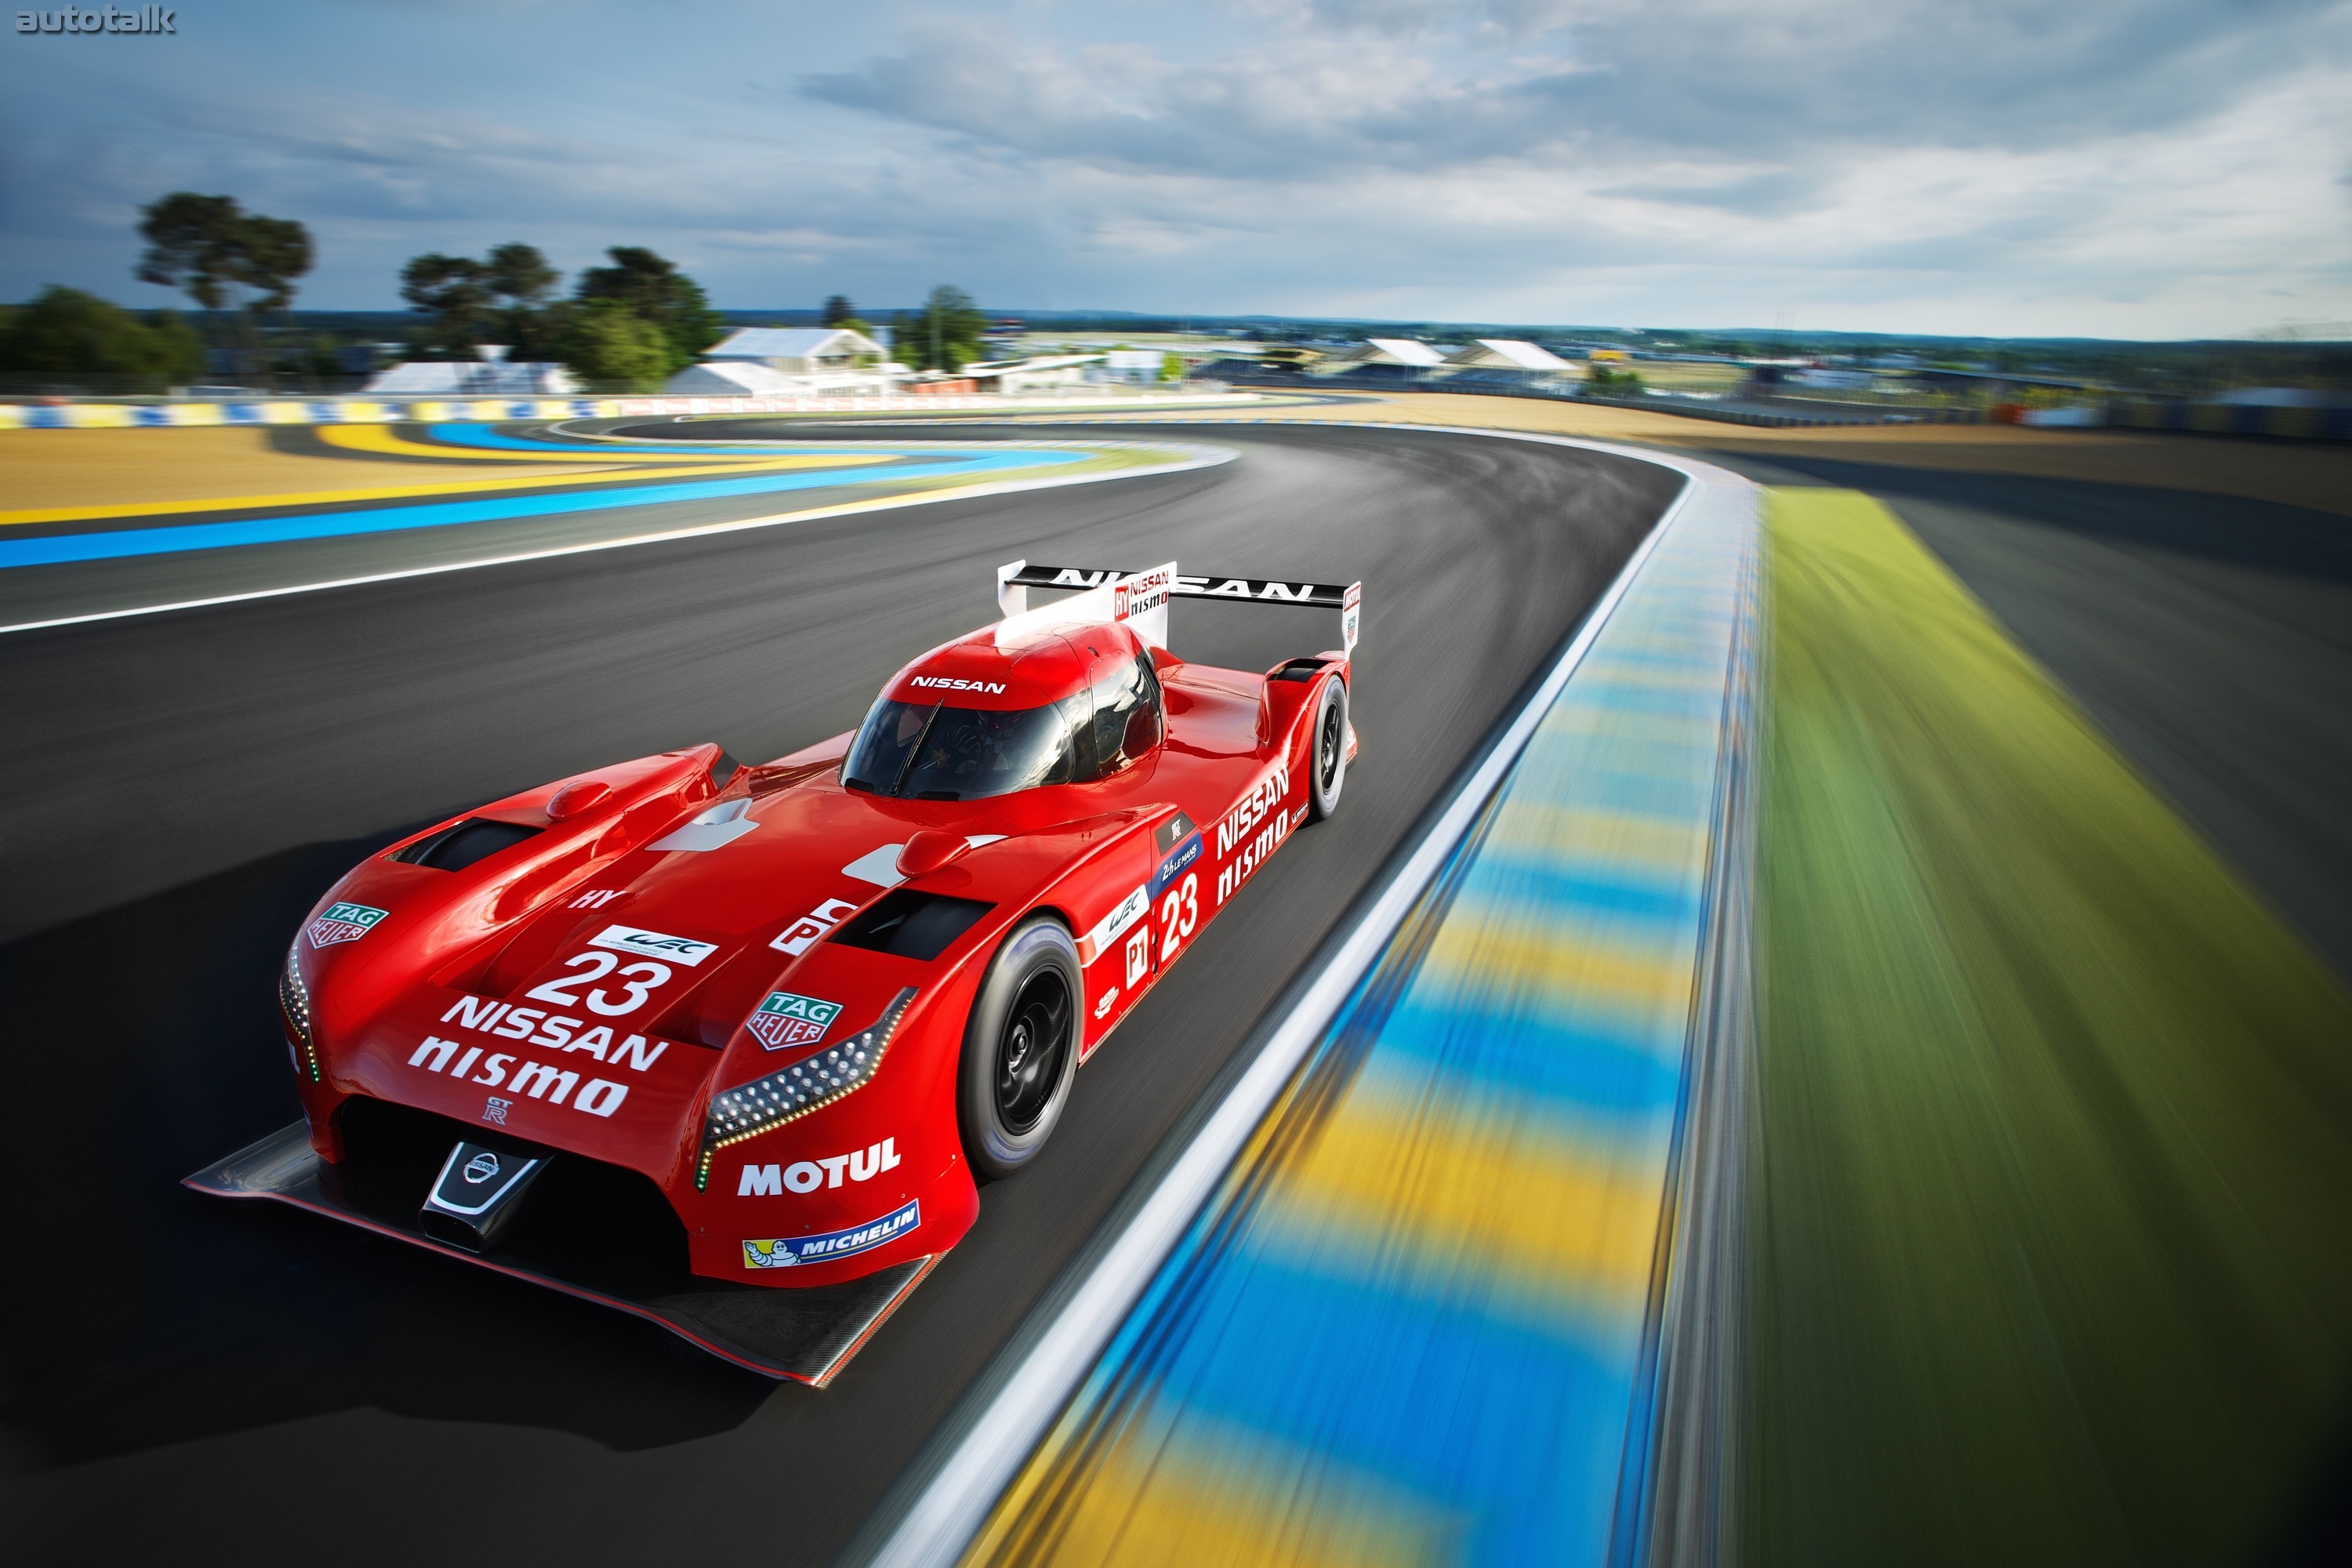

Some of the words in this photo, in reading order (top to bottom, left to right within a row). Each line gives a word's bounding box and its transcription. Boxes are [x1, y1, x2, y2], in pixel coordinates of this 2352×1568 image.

[1048, 568, 1314, 601] NISAN
[1131, 571, 1169, 597] NISSAN
[1116, 590, 1129, 617] HY
[1131, 591, 1168, 616] nismo
[910, 676, 1006, 695] NISSAN
[1218, 763, 1290, 861] NISSAN
[1174, 857, 1181, 871] LE
[1181, 844, 1197, 865] MANS
[1218, 808, 1288, 906] nismo
[567, 889, 626, 909] HY
[1109, 891, 1140, 933] WEC
[330, 905, 379, 924] TAG
[1161, 873, 1198, 964] 23
[311, 920, 363, 945] HEUER
[622, 934, 709, 954] WEC
[1129, 935, 1145, 979] P1
[524, 951, 672, 1017] 23
[771, 995, 833, 1022] TAG
[440, 995, 670, 1072] NISSAN
[752, 1014, 822, 1045] HEUER
[408, 1036, 629, 1118] nismo
[481, 1104, 507, 1126] R
[488, 1096, 514, 1109] GT
[469, 1160, 495, 1173] NISSAN
[737, 1137, 901, 1196] MOTUL
[801, 1207, 916, 1255] MICHELIN
